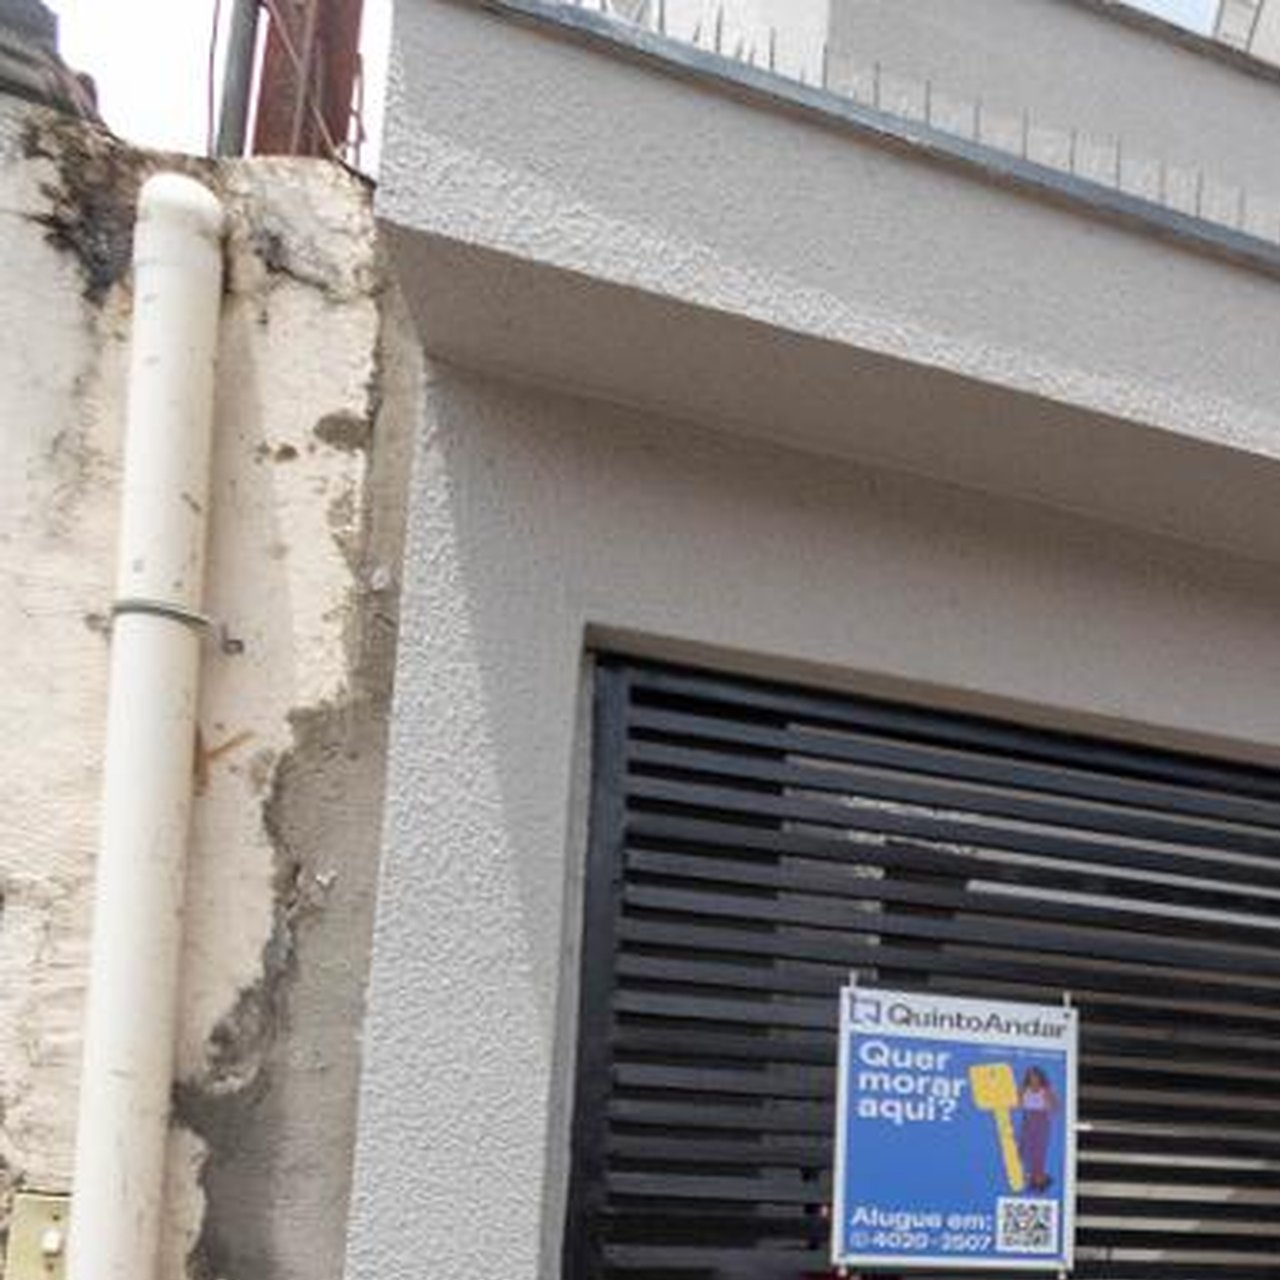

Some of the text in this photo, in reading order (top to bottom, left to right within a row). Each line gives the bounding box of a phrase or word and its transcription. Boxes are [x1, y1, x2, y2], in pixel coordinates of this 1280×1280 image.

[886, 1002, 1068, 1038] QuintoAndar
[857, 1040, 951, 1071] Quer
[857, 1070, 966, 1097] morar
[856, 1096, 956, 1125] aqui?
[850, 1206, 993, 1231] Alugue em:
